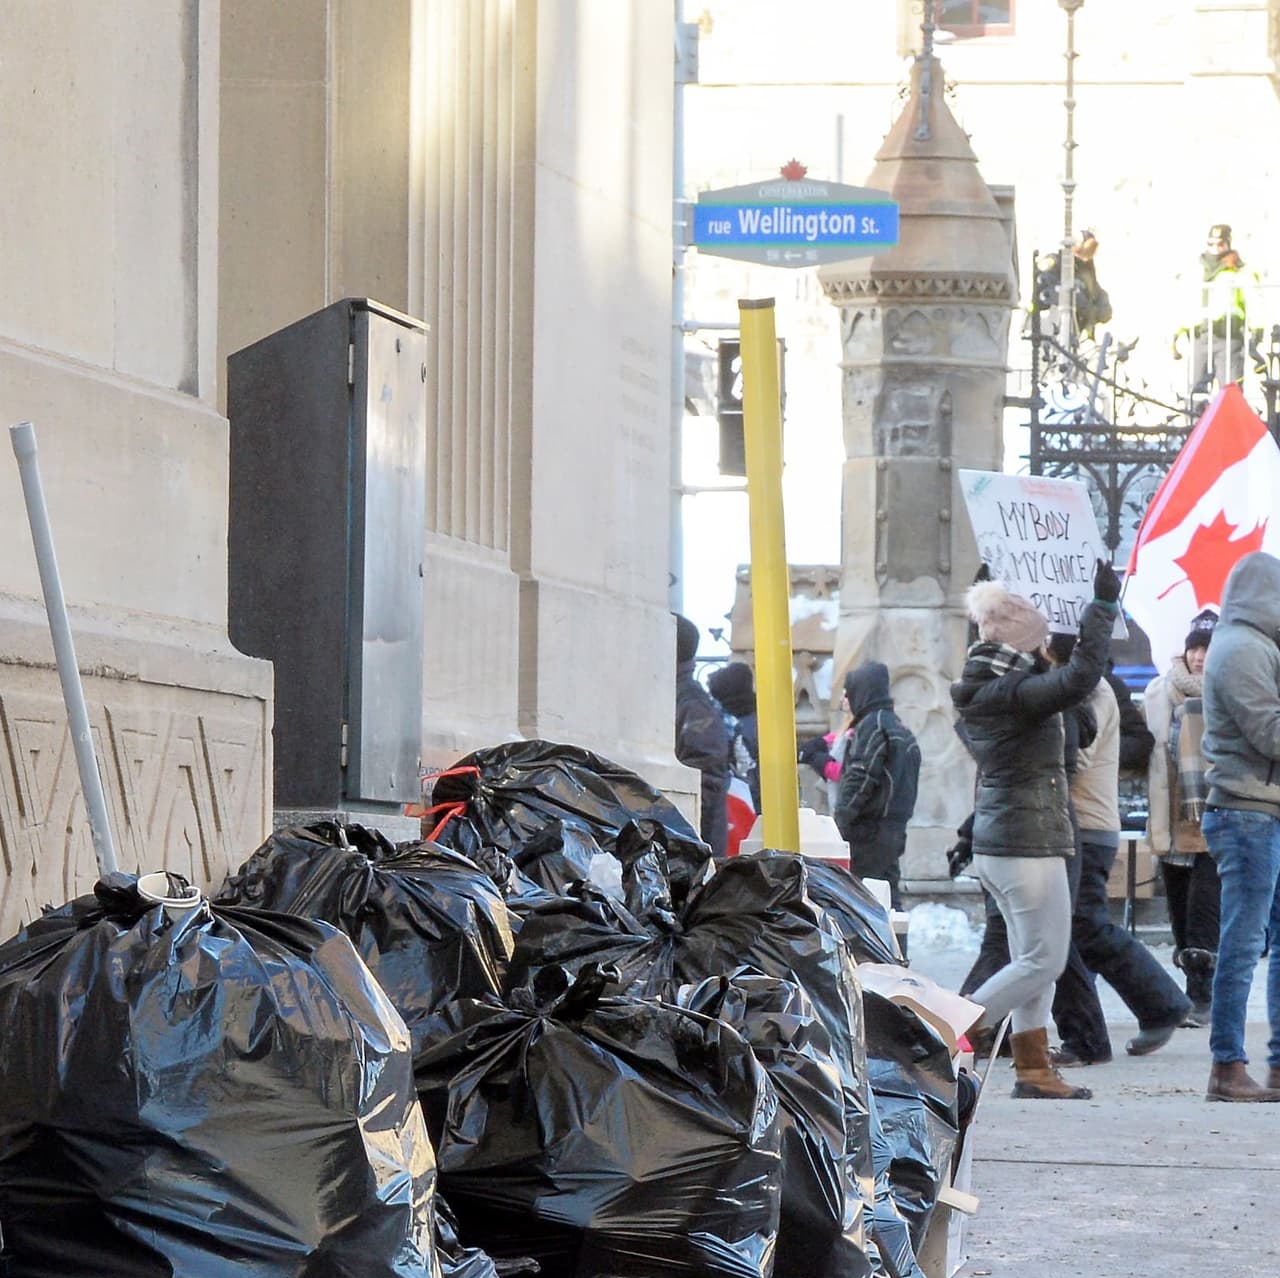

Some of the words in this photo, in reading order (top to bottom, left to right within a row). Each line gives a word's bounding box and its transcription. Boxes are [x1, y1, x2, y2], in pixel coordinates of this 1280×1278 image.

[708, 221, 732, 235] rue
[738, 207, 856, 241] Wellington
[861, 217, 880, 235] St.
[997, 501, 1028, 540] MY
[1028, 502, 1070, 541] BODY
[1010, 551, 1038, 583] MY
